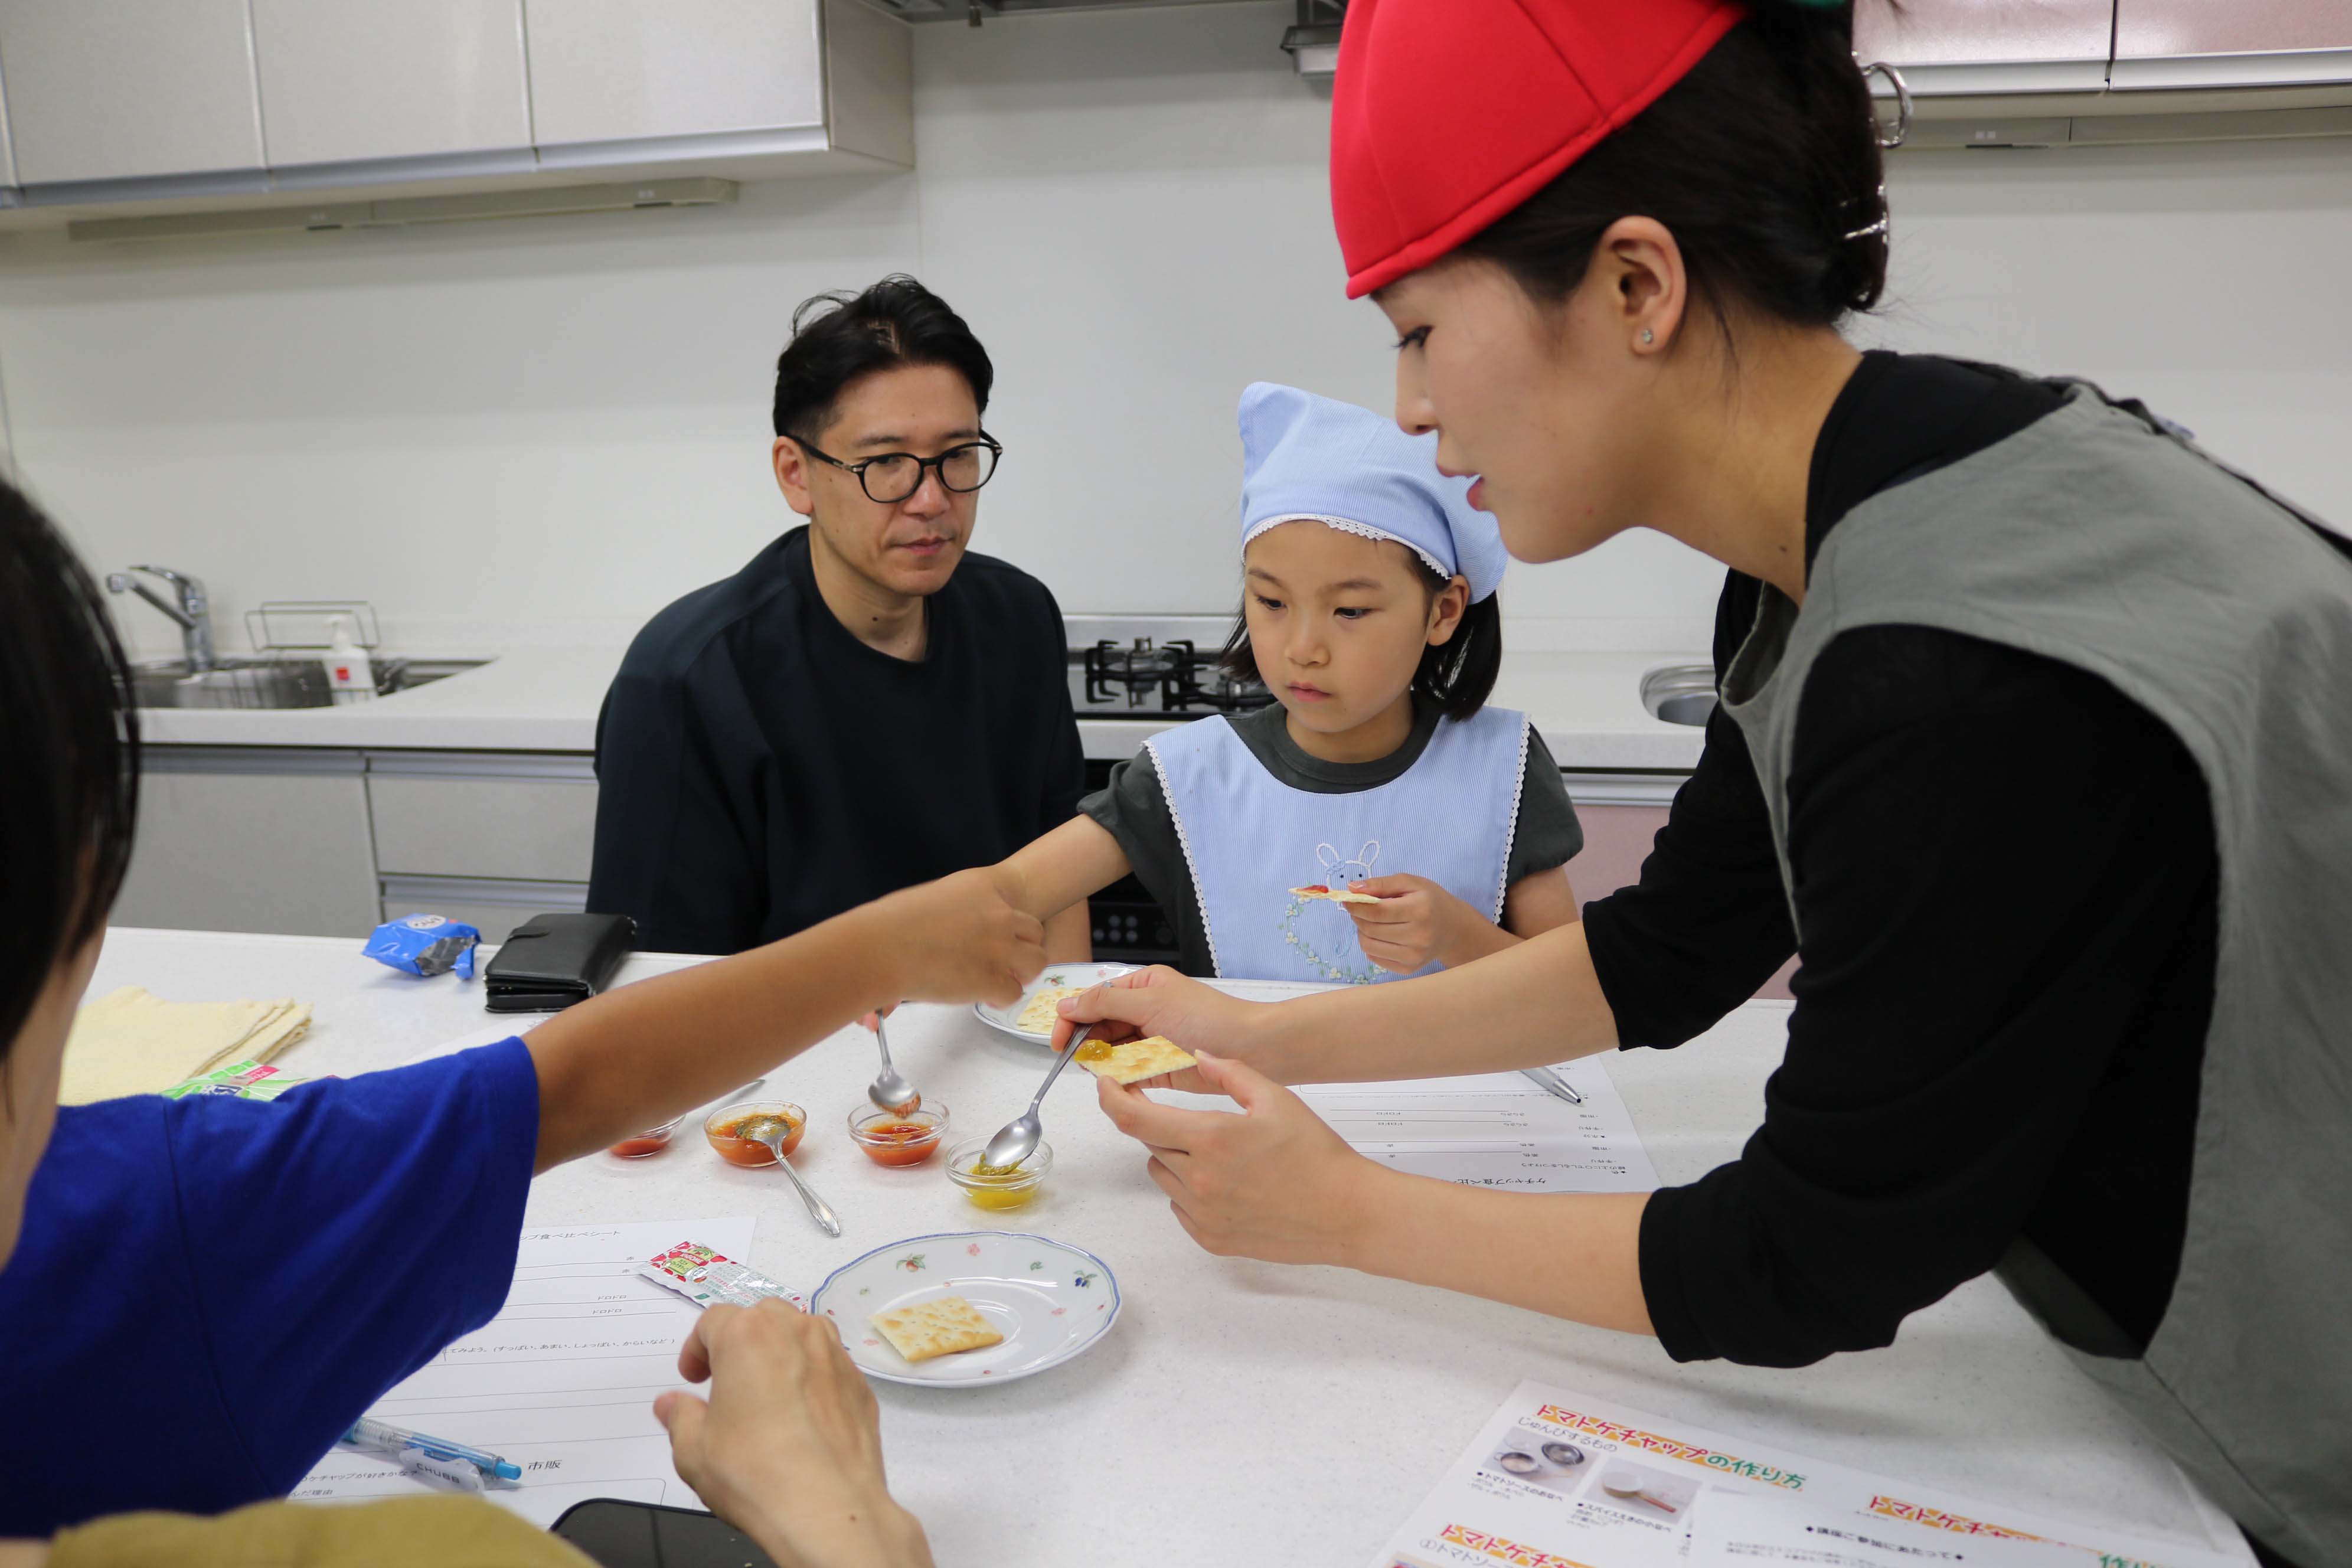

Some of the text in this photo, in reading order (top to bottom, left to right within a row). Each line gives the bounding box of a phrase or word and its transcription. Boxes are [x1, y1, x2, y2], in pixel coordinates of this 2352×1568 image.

[1518, 1417, 1618, 1452] じゅんびするもの
[1537, 1404, 1808, 1489] トマトケチャップの作り方
[416, 1462, 460, 1484] CHUBB
[528, 1459, 563, 1471] 市販
